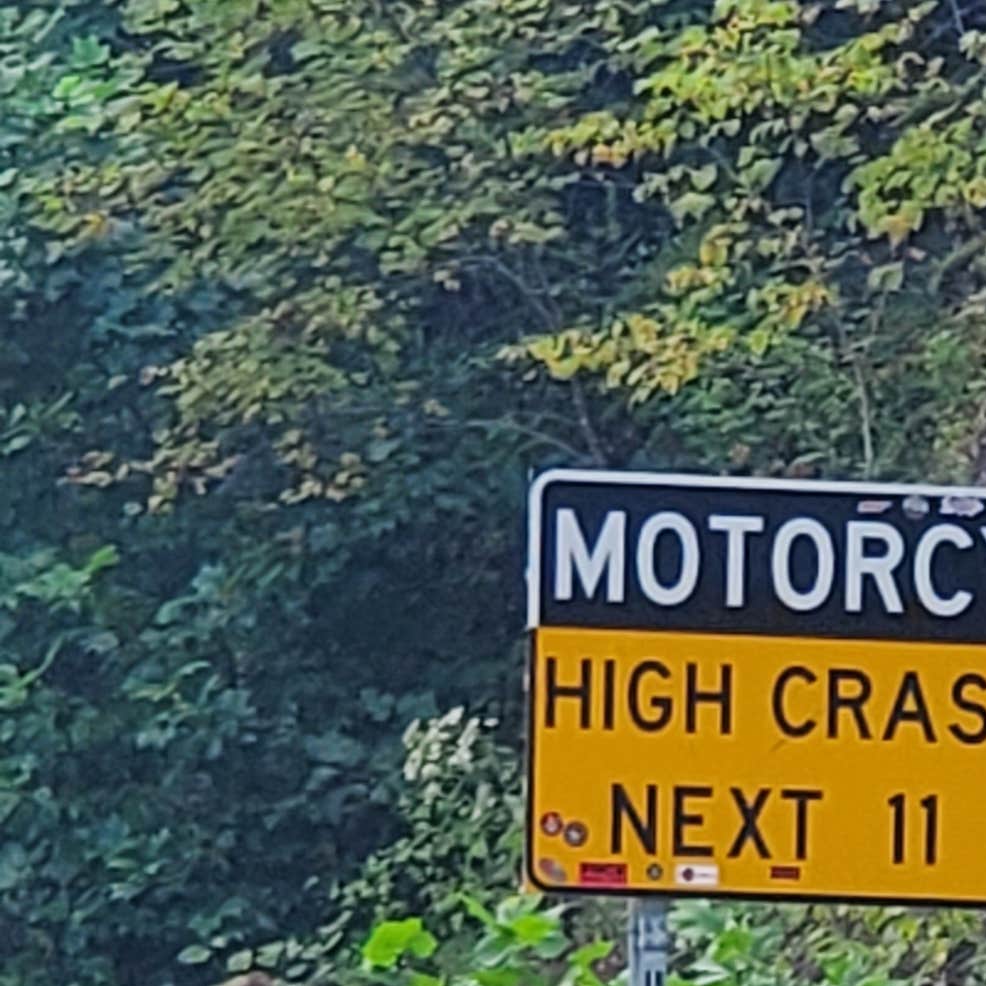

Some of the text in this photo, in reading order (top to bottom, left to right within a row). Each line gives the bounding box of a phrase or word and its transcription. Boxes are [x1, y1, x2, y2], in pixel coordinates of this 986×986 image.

[544, 656, 733, 735] HIGH
[611, 783, 822, 860] NEXT
[888, 793, 938, 865] 11
